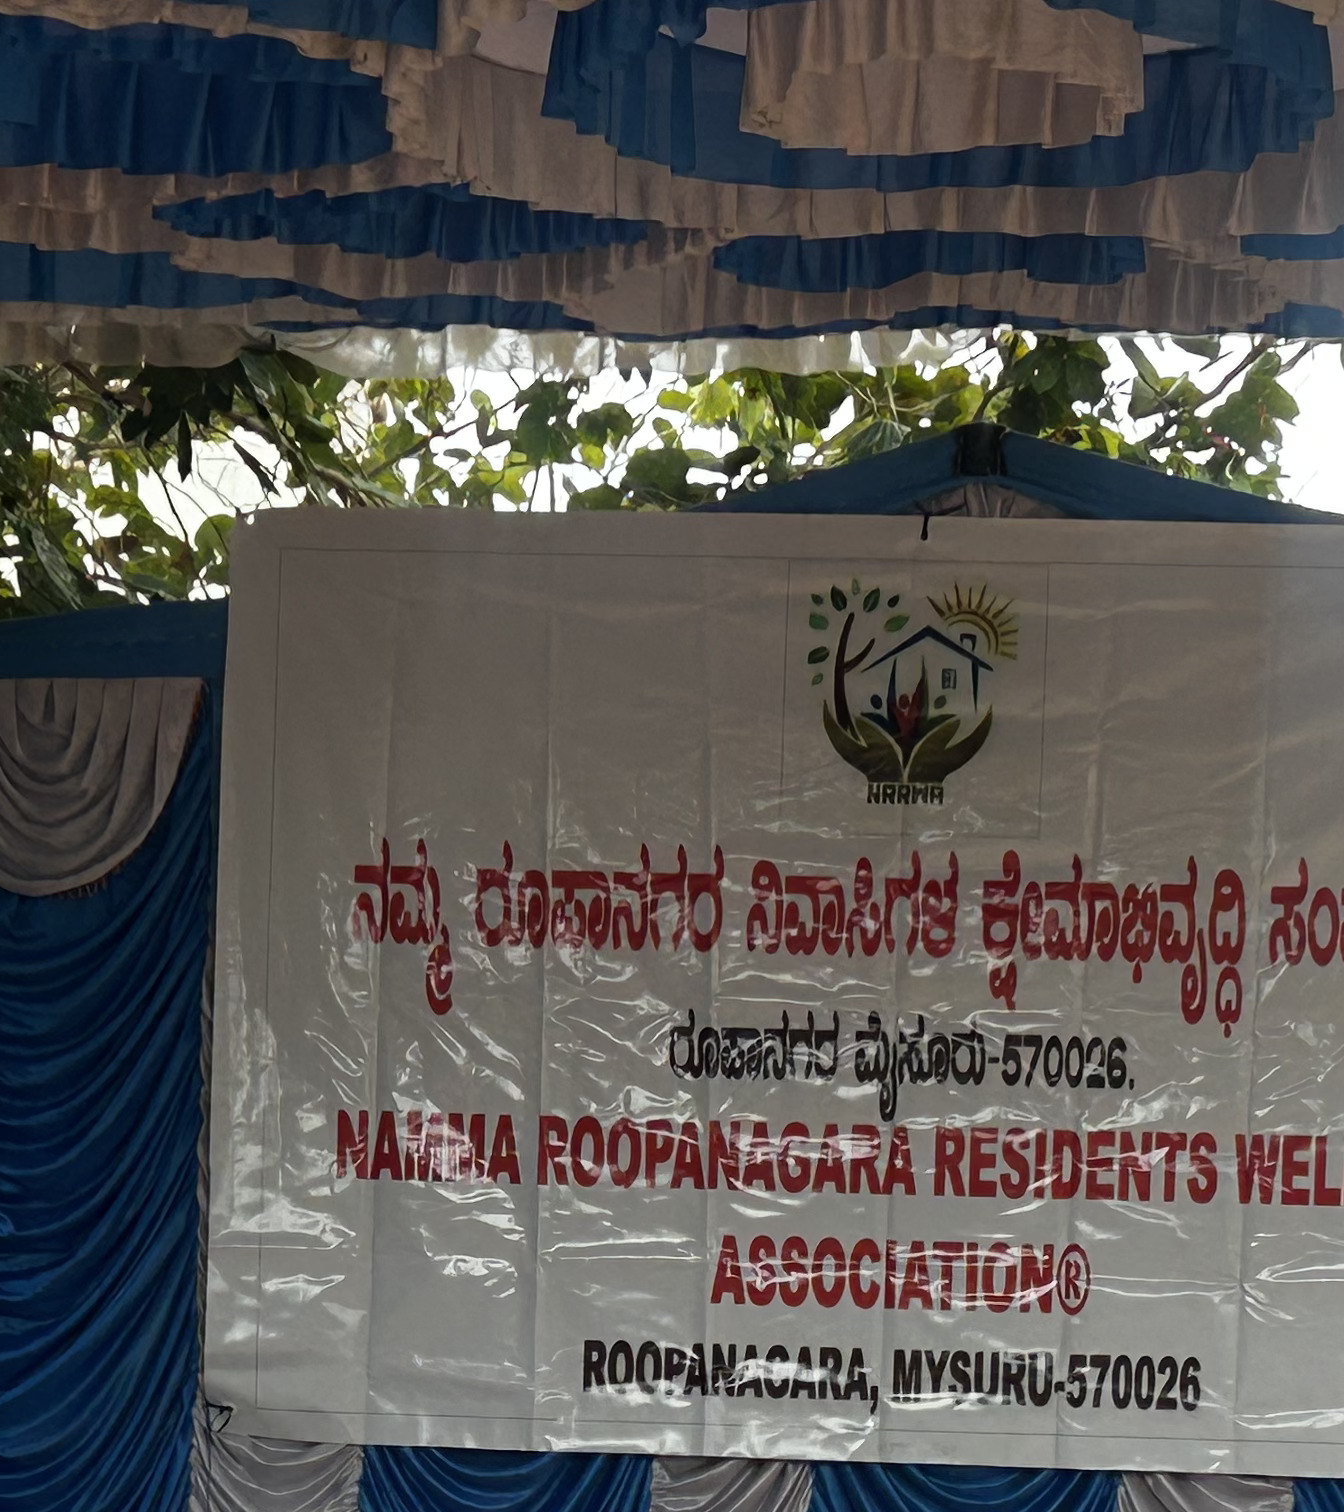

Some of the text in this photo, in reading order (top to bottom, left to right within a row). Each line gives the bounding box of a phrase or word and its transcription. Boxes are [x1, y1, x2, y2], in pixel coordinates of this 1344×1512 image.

[352, 837, 454, 1016] ನಮ್ಮ
[473, 839, 724, 953] ರೂಪಾನಗರ
[746, 850, 959, 957] ನಿವಾಸಿಗಳ
[982, 849, 1246, 1038] ಕ್ಷೇಮಾಭಿವೃದ್ಧಿ
[668, 1009, 840, 1082] ರೂಪಾನಗರ
[336, 1110, 522, 1184] NAMMA
[537, 1115, 917, 1196] ROOPANAGARA
[933, 1126, 1218, 1204] RESIDENTS
[710, 1235, 1092, 1316] ASSOCIATION®
[582, 1339, 1202, 1415] ROOPANAGARA, MYSURU-570026
